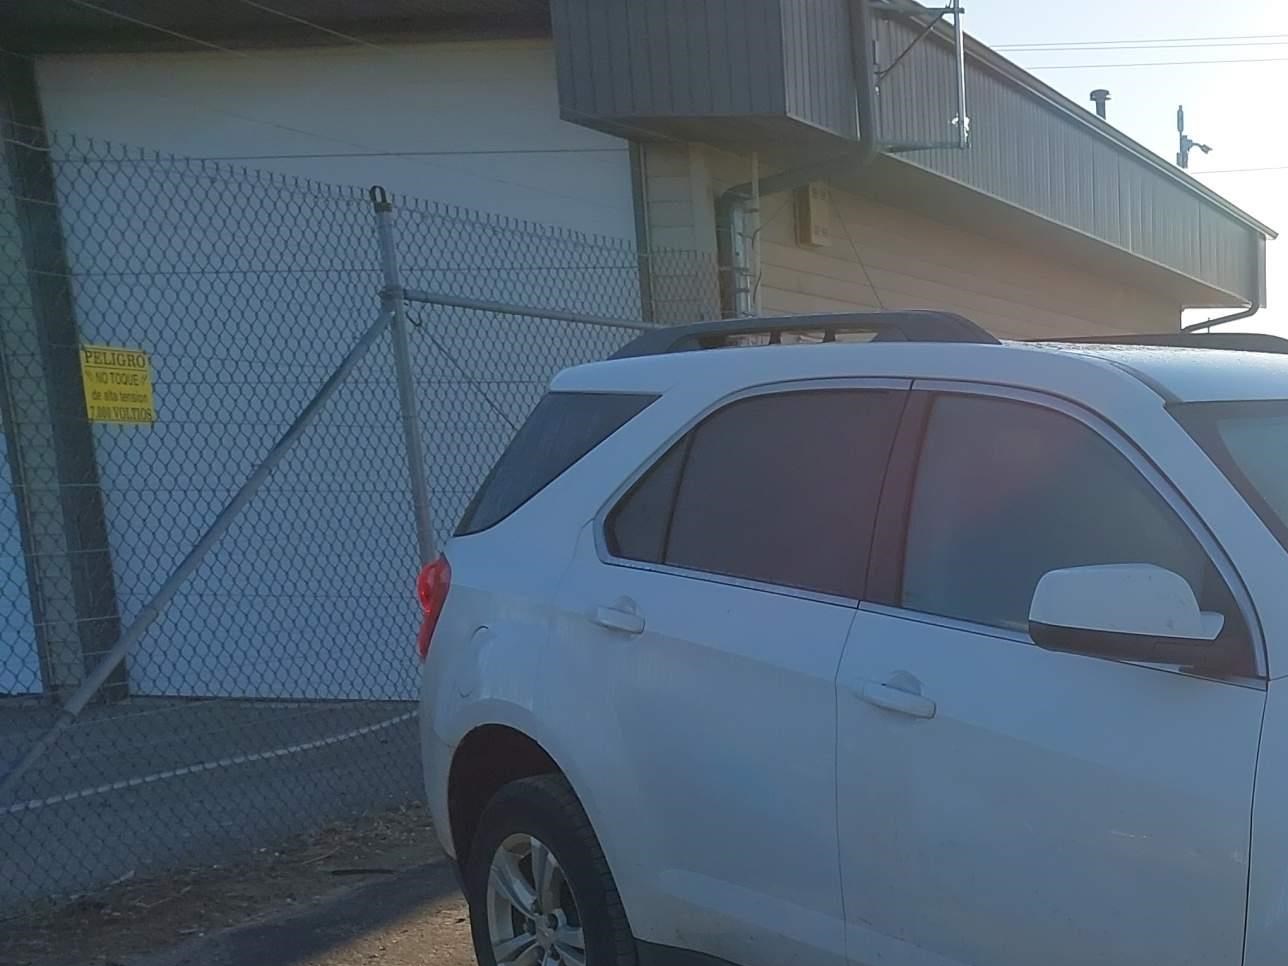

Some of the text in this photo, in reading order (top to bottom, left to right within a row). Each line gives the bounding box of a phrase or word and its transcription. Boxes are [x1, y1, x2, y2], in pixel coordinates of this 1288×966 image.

[85, 351, 146, 368] PELIGRO
[96, 372, 139, 386] NO TOQUE
[112, 406, 152, 420] VOLTIOS
